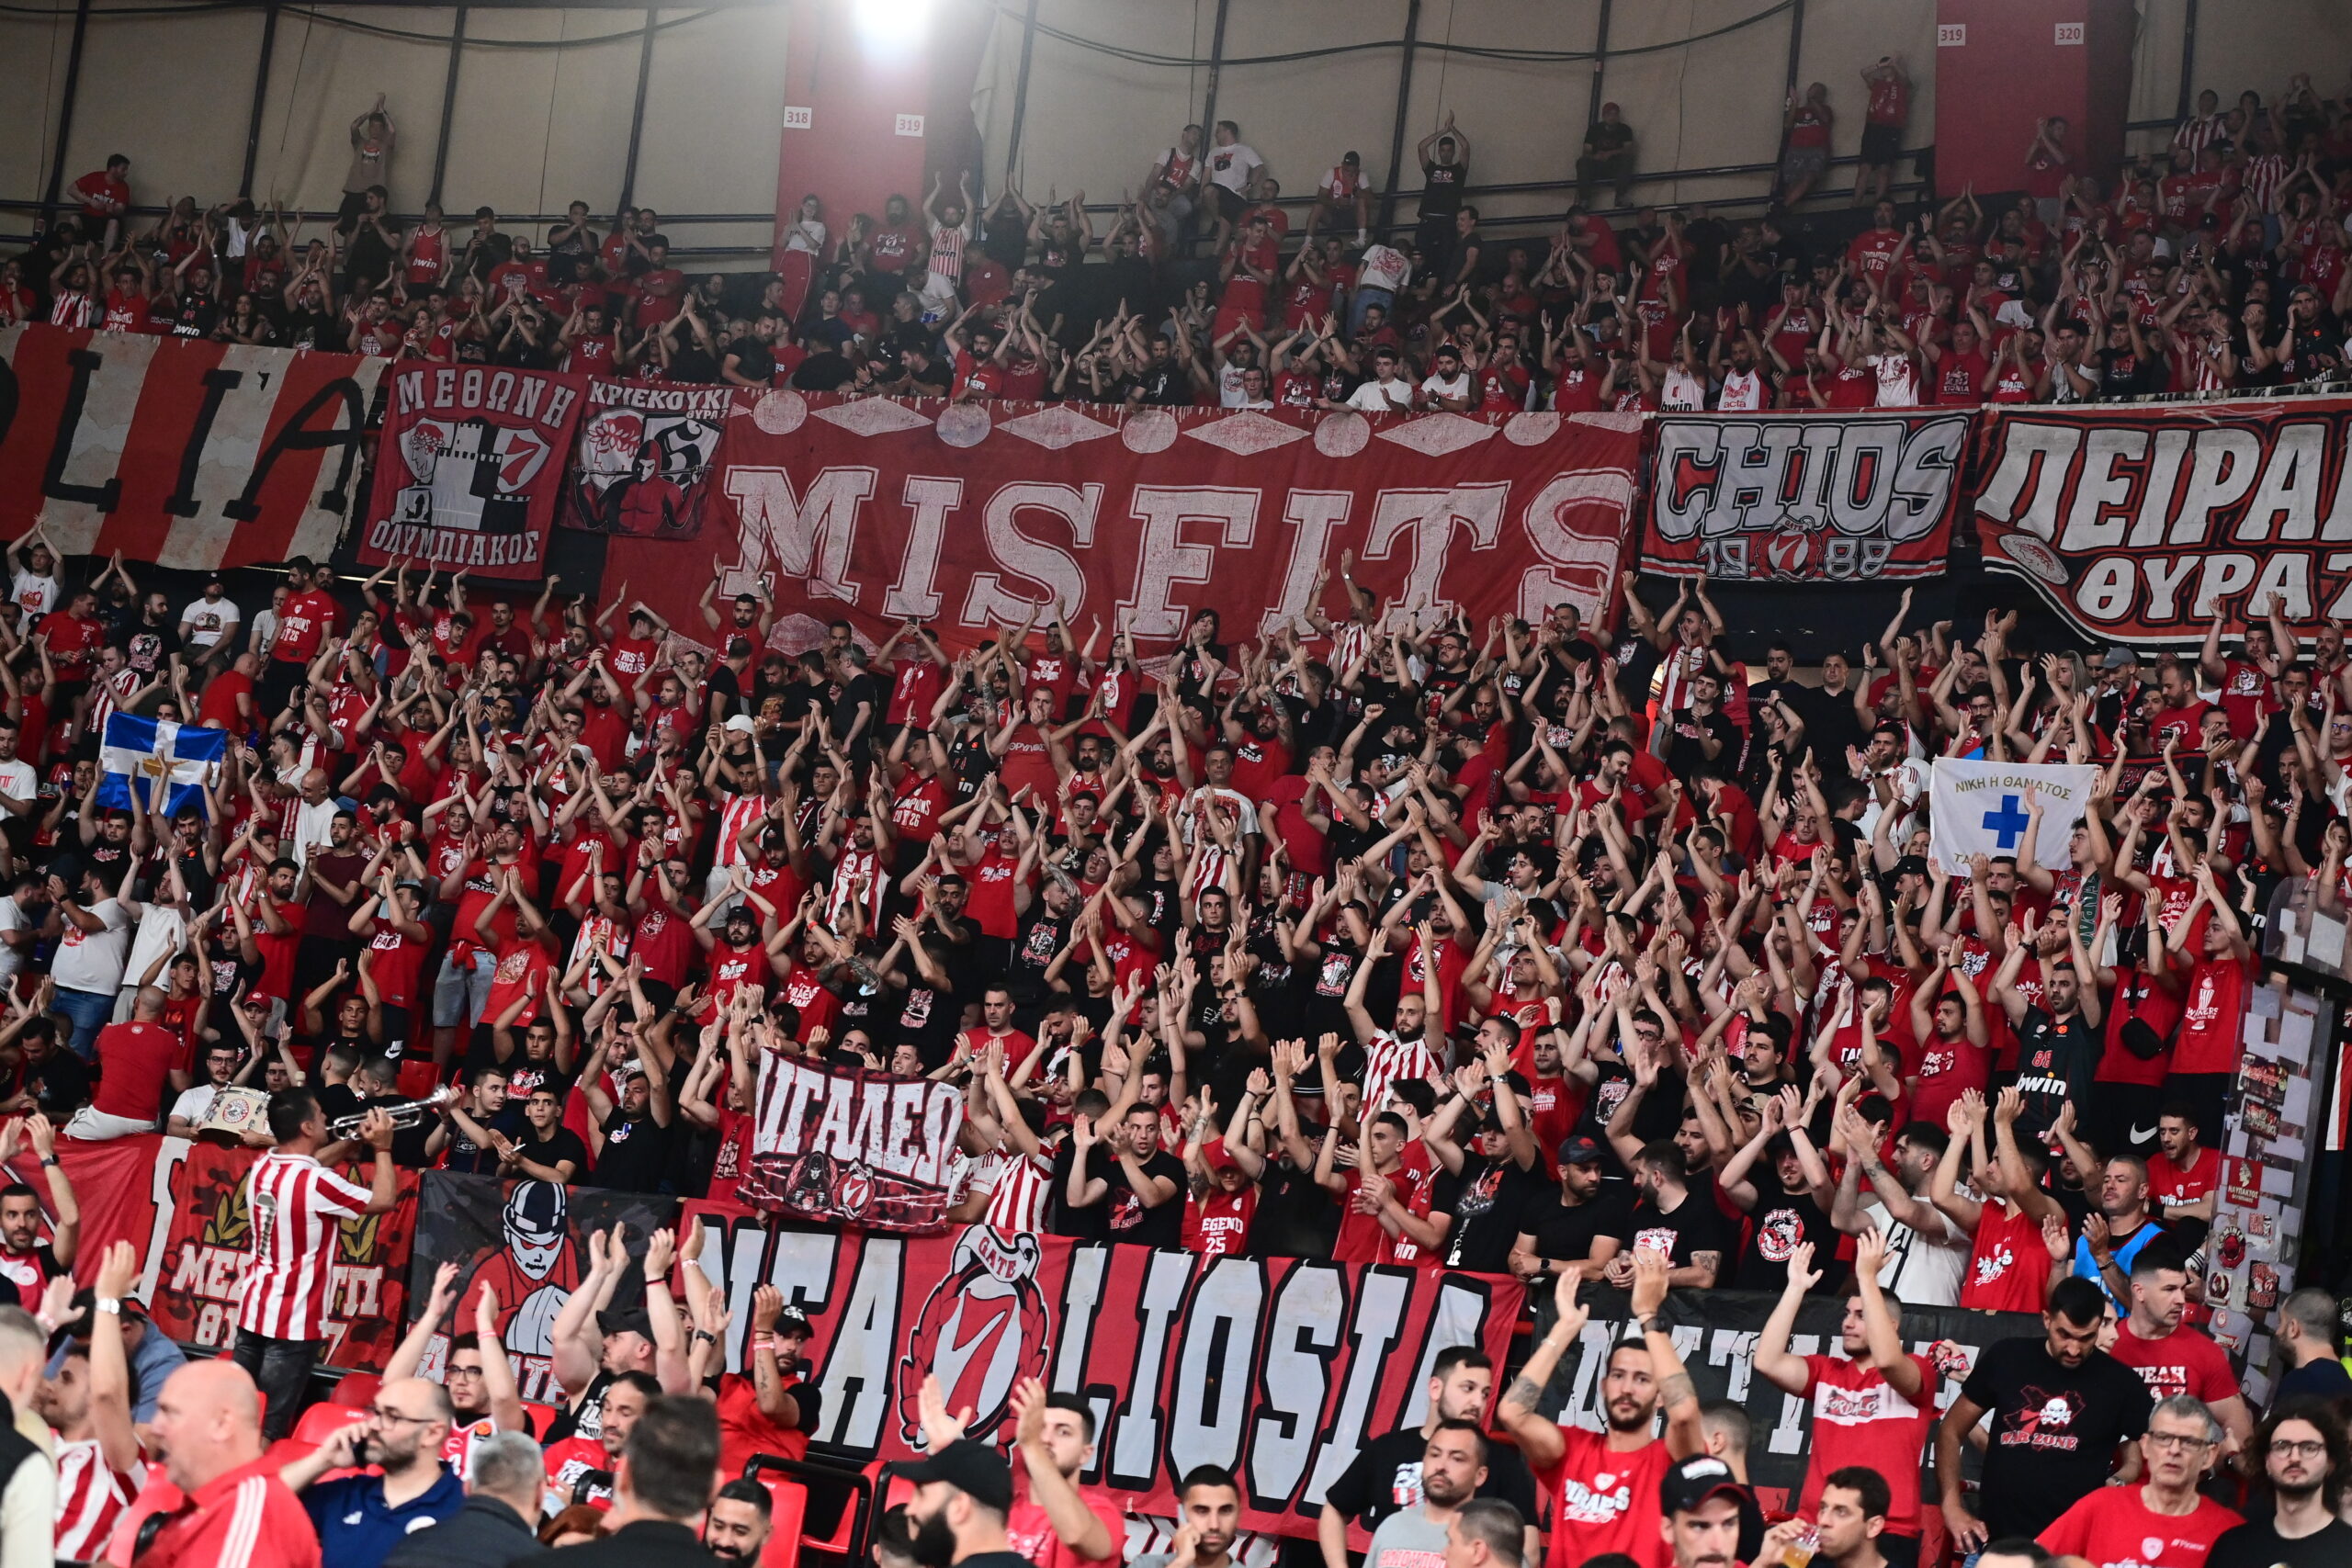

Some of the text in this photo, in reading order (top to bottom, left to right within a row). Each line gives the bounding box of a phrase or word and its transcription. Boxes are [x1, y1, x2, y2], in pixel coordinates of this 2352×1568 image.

[1940, 29, 1962, 41] 319
[2058, 28, 2081, 39] 320
[786, 111, 808, 124] 318
[898, 118, 921, 131] 319
[172, 322, 200, 337] bwin
[397, 368, 576, 428] ΜΕΘΩΝΗ
[588, 380, 734, 412] ΚΡΙΕΚΟΥΚΙ
[1724, 399, 1747, 410] acta
[685, 407, 718, 421] ΘΥΡΑ
[1657, 419, 1967, 542] CHIOS
[369, 519, 539, 567] ΟΛΥΜΠΙΑΚΟΣ
[718, 464, 1634, 643] MISFITS
[1698, 536, 1749, 579] 19
[2076, 552, 2312, 620] ΘΥΡΑ
[618, 649, 637, 662] THIS
[1956, 777, 1985, 793] ΝΙΚΗ
[2003, 776, 2072, 800] ΘΑΝΑΤΟΣ
[910, 813, 922, 827] 26
[2032, 1050, 2053, 1068] 88
[2018, 1072, 2066, 1096] bwin
[1204, 1237, 1227, 1253] 25
[979, 1236, 1018, 1279] GATE
[945, 1288, 1017, 1427] 7
[2000, 1431, 2078, 1451] WAR ZONE
